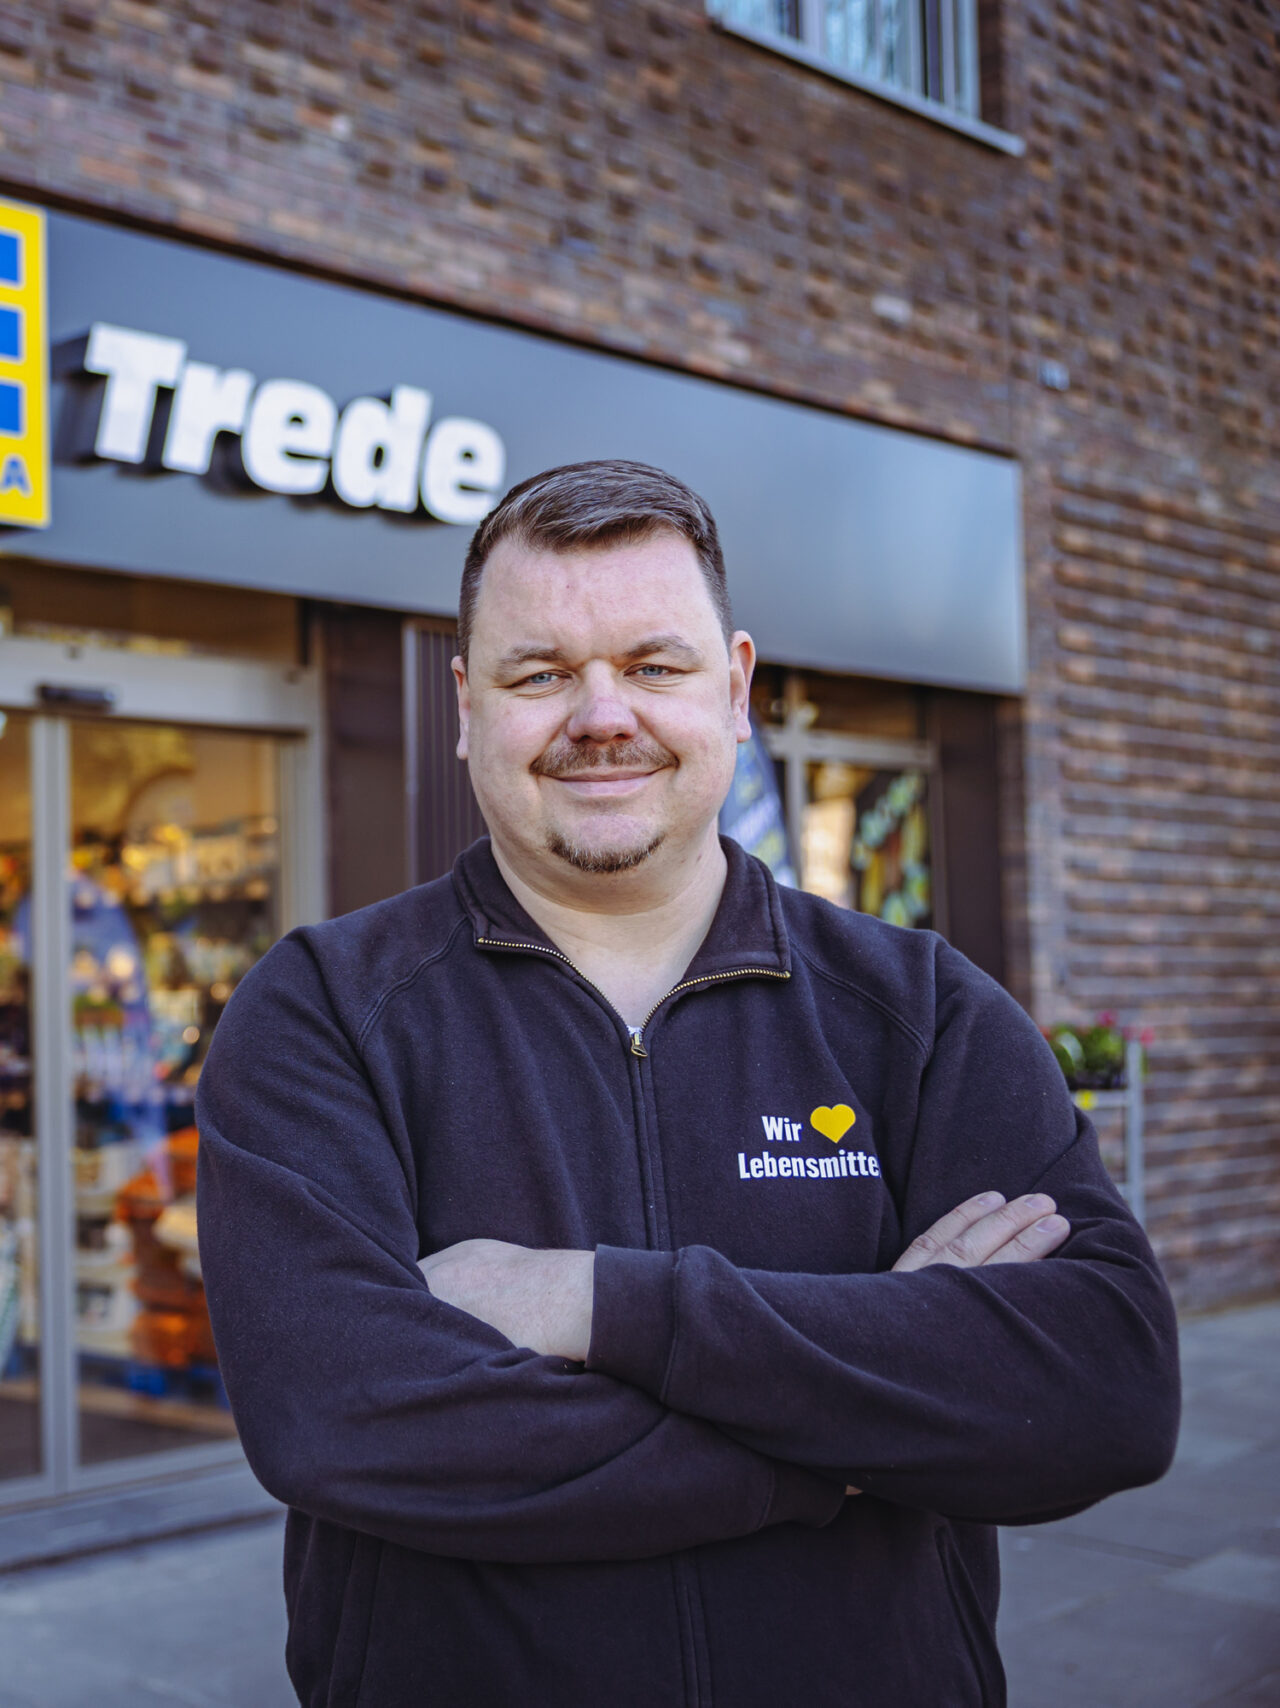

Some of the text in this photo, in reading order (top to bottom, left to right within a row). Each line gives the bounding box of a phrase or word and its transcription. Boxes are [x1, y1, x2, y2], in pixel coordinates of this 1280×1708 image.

[83, 321, 506, 525] Trede
[761, 1115, 803, 1142] Wir
[737, 1149, 881, 1179] Lebensmitte
